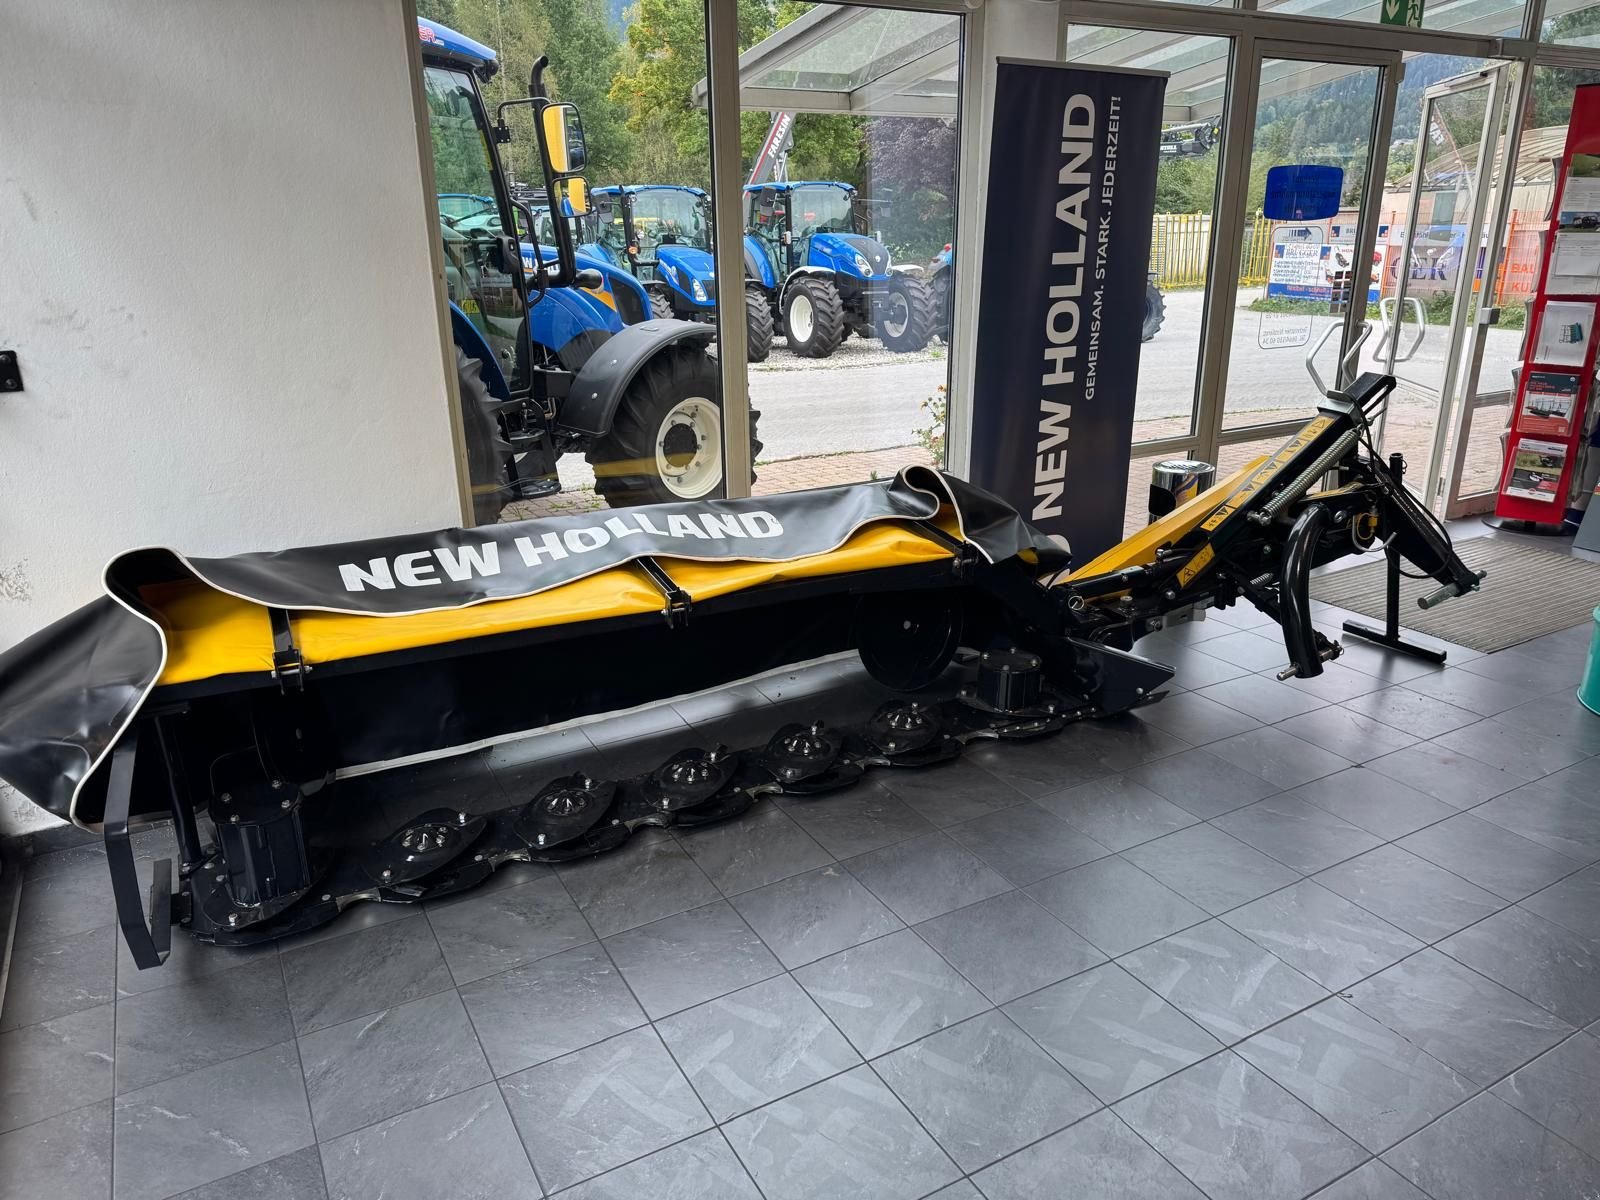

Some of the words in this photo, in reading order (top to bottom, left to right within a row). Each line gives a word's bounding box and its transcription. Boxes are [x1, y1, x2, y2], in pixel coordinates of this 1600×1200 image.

[767, 114, 791, 158] FARESIN
[1101, 96, 1121, 207] JEDERZEIT!
[1042, 93, 1096, 387] HOLLAND
[1095, 210, 1112, 279] STARK.
[1085, 283, 1105, 401] GEMEINSAM.
[1032, 399, 1073, 521] NEW
[338, 541, 501, 592] NEW
[516, 510, 784, 568] HOLLAND
